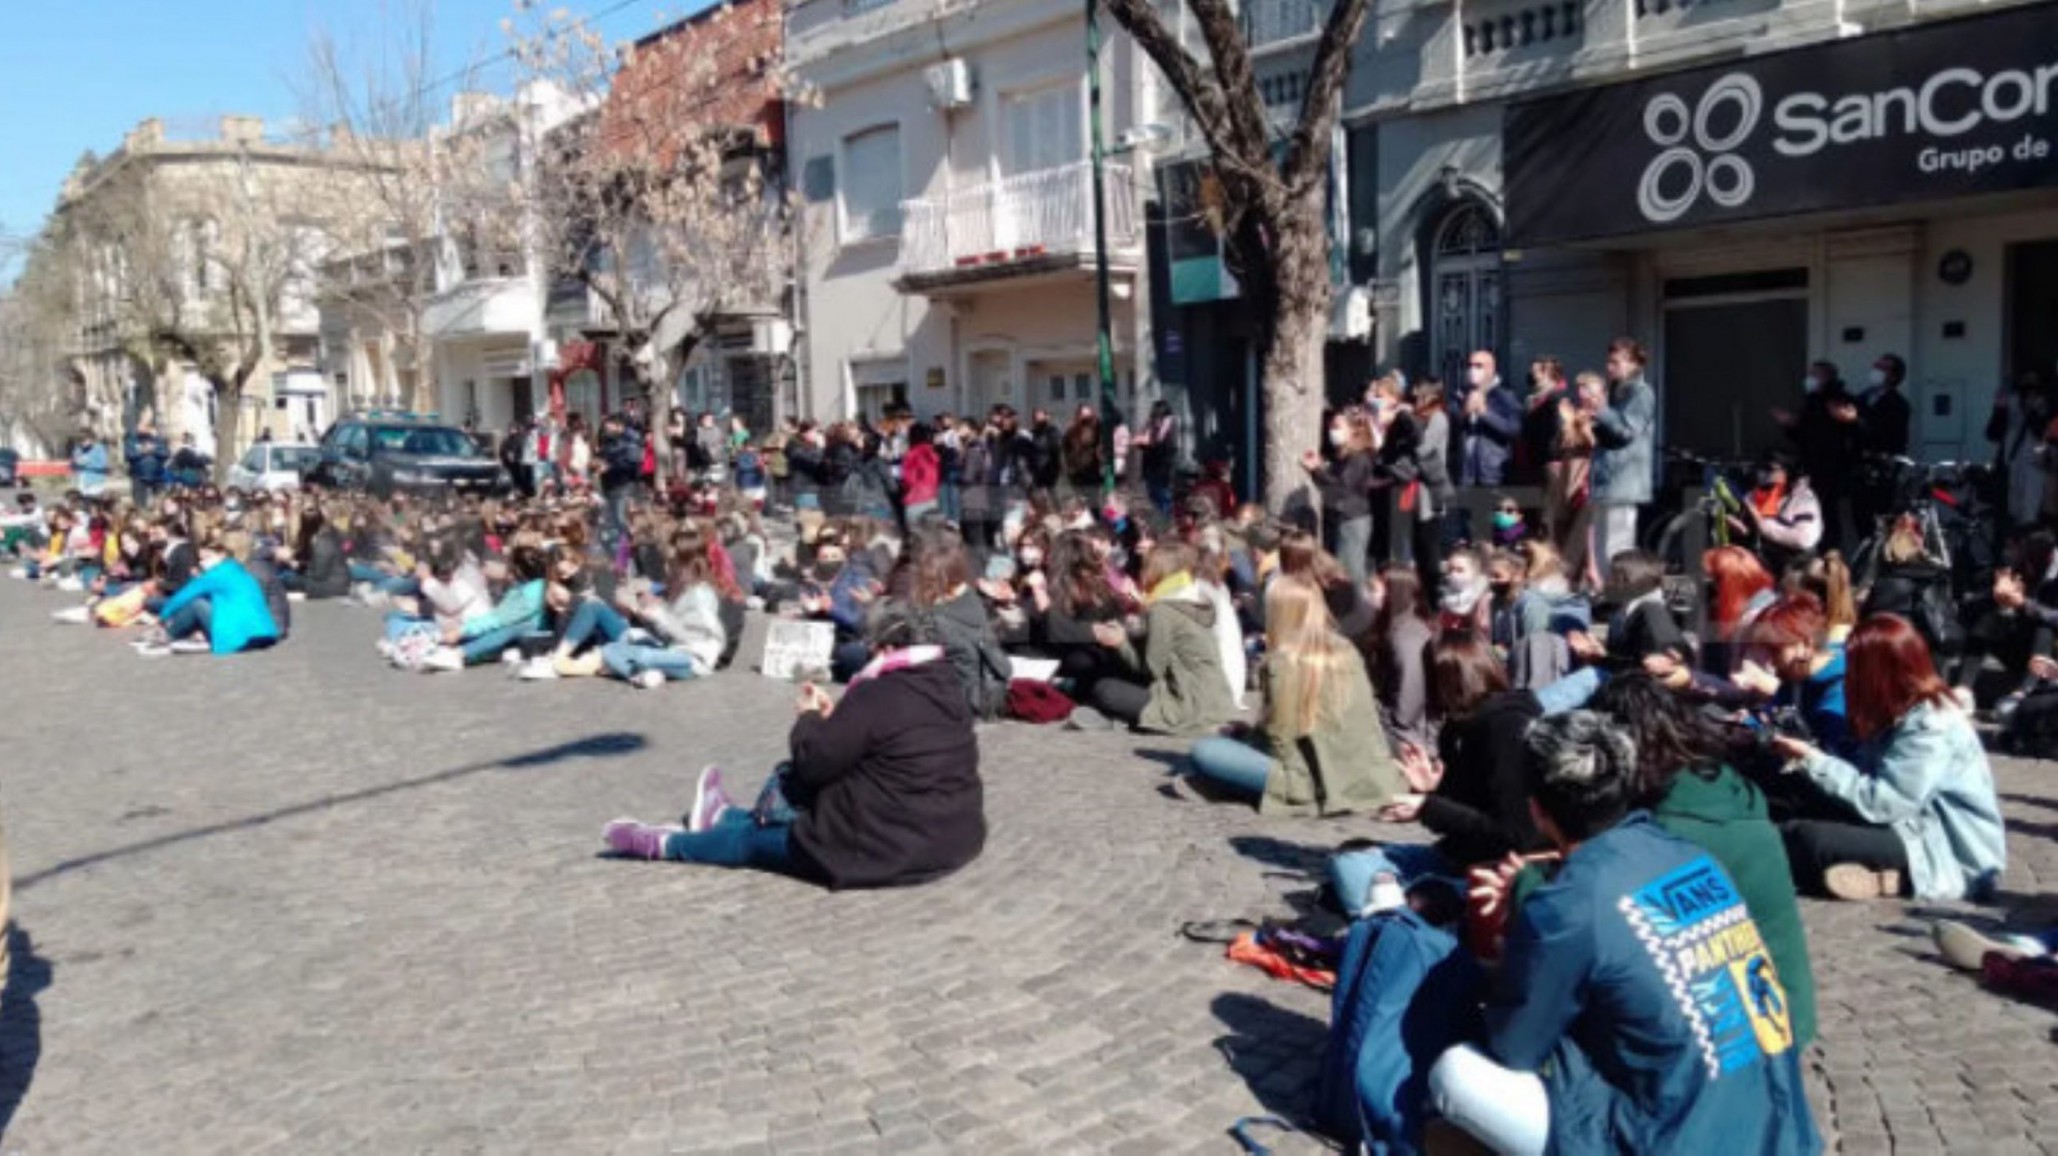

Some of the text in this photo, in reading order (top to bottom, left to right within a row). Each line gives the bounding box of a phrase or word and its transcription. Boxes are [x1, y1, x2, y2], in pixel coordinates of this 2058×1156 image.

[1918, 133, 2050, 173] Grupo de
[1643, 866, 1730, 922] VANS
